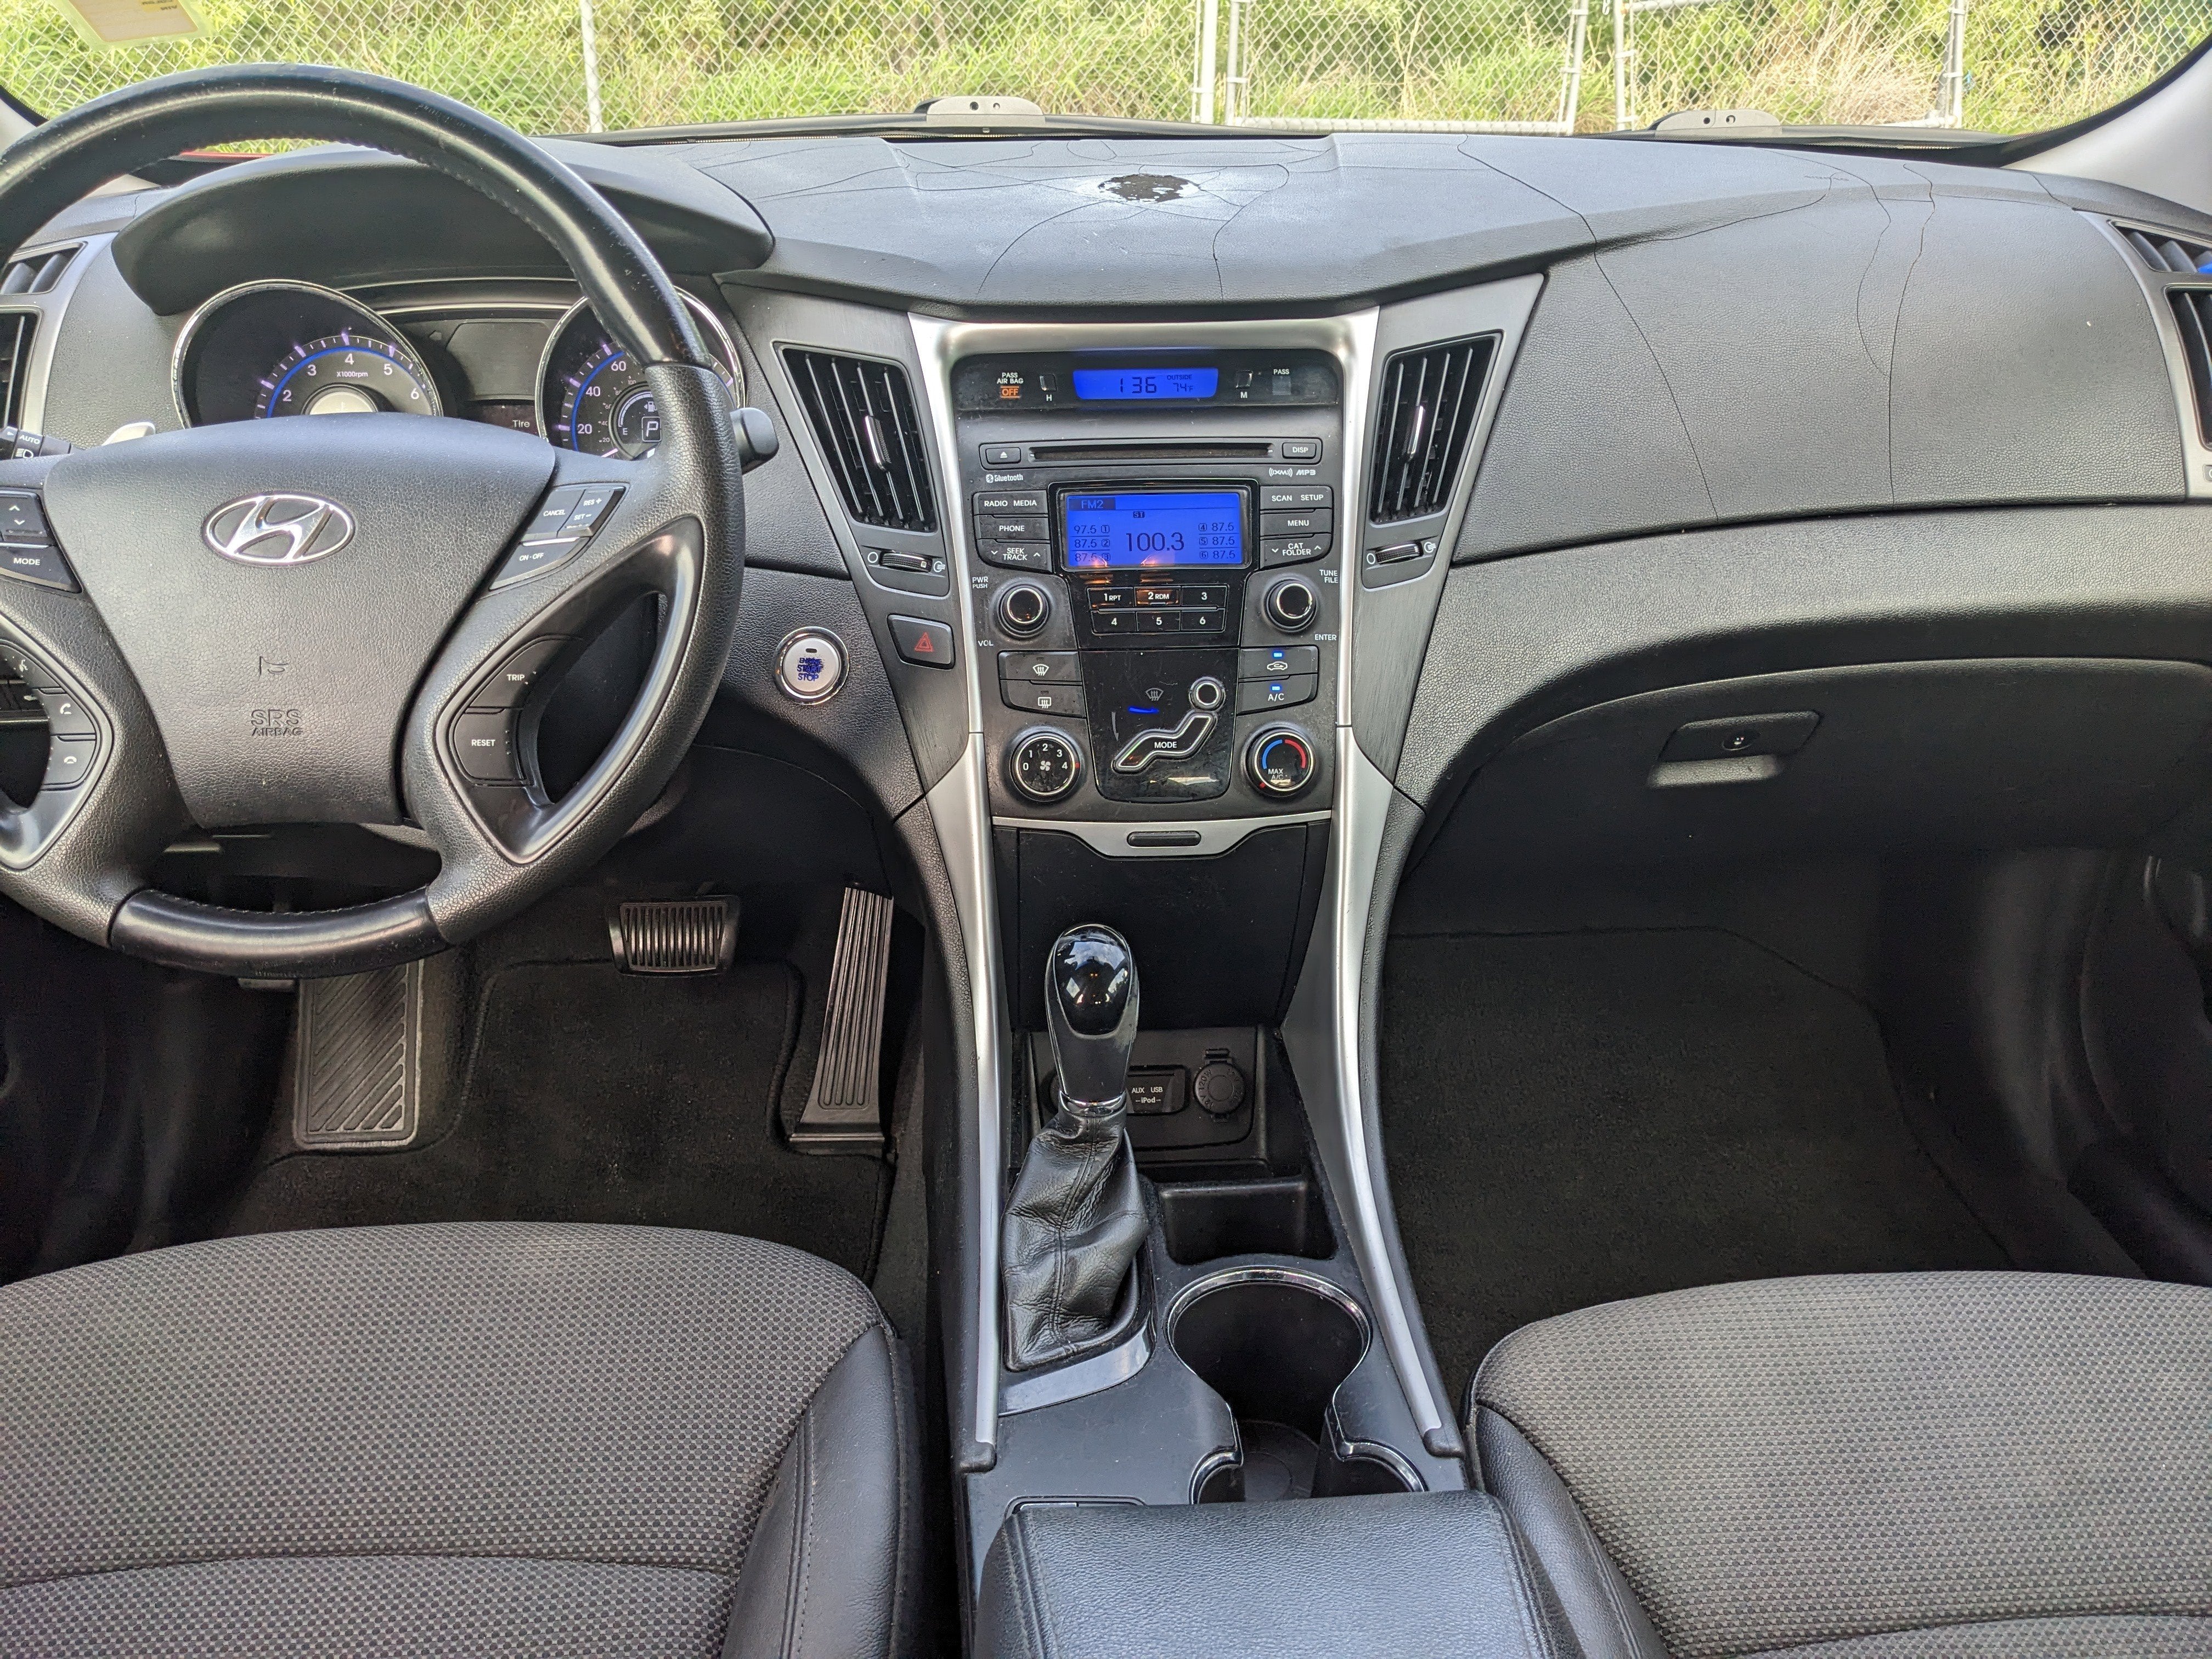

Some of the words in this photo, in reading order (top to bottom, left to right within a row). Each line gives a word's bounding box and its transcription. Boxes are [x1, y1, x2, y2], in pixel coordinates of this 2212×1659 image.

[345, 354, 354, 364] 4
[307, 365, 317, 376] 3
[384, 364, 393, 375] 5
[611, 361, 627, 372] 60
[283, 390, 292, 402] 2
[411, 388, 419, 399] 6
[585, 386, 601, 397] 40
[578, 424, 592, 435] 20
[646, 421, 658, 437] P
[19, 435, 40, 444] AUTO
[994, 473, 1024, 482] Bluetooth
[1081, 500, 1104, 509] FM2
[1074, 525, 1097, 534] 97.5
[1211, 522, 1234, 531] 87.5
[1074, 539, 1097, 548] 87.5
[1126, 532, 1184, 551] 100.3
[1212, 536, 1235, 545] 87.5
[1075, 553, 1097, 562] 87.5
[1213, 550, 1235, 559] 87.5
[14, 557, 41, 566] MODE
[1156, 617, 1163, 625] 5
[1199, 617, 1206, 625] 6
[798, 673, 819, 681] STOP
[1268, 693, 1284, 702] A/C
[251, 709, 302, 727] SRS
[252, 727, 303, 736] AIRBAG
[1042, 743, 1048, 752] 2
[1057, 749, 1063, 758] 3
